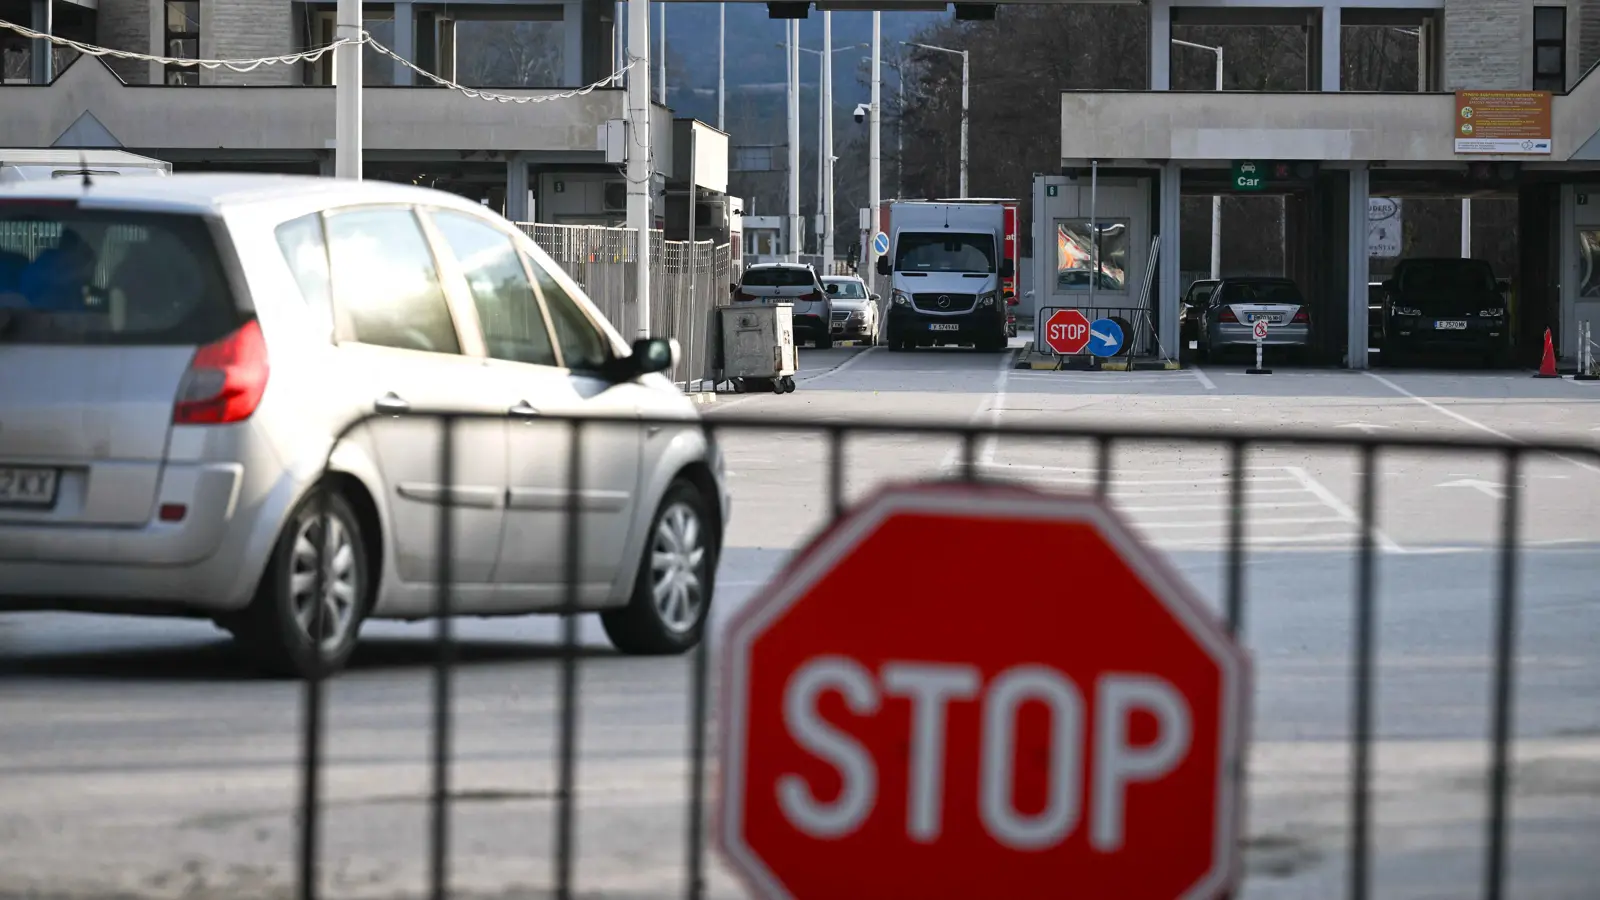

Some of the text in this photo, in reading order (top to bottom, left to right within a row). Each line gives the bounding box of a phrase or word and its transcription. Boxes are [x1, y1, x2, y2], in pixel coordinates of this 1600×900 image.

[1237, 176, 1260, 186] Car
[1049, 186, 1055, 196] 6
[1050, 324, 1086, 340] STOP
[775, 654, 1194, 852] STOP
